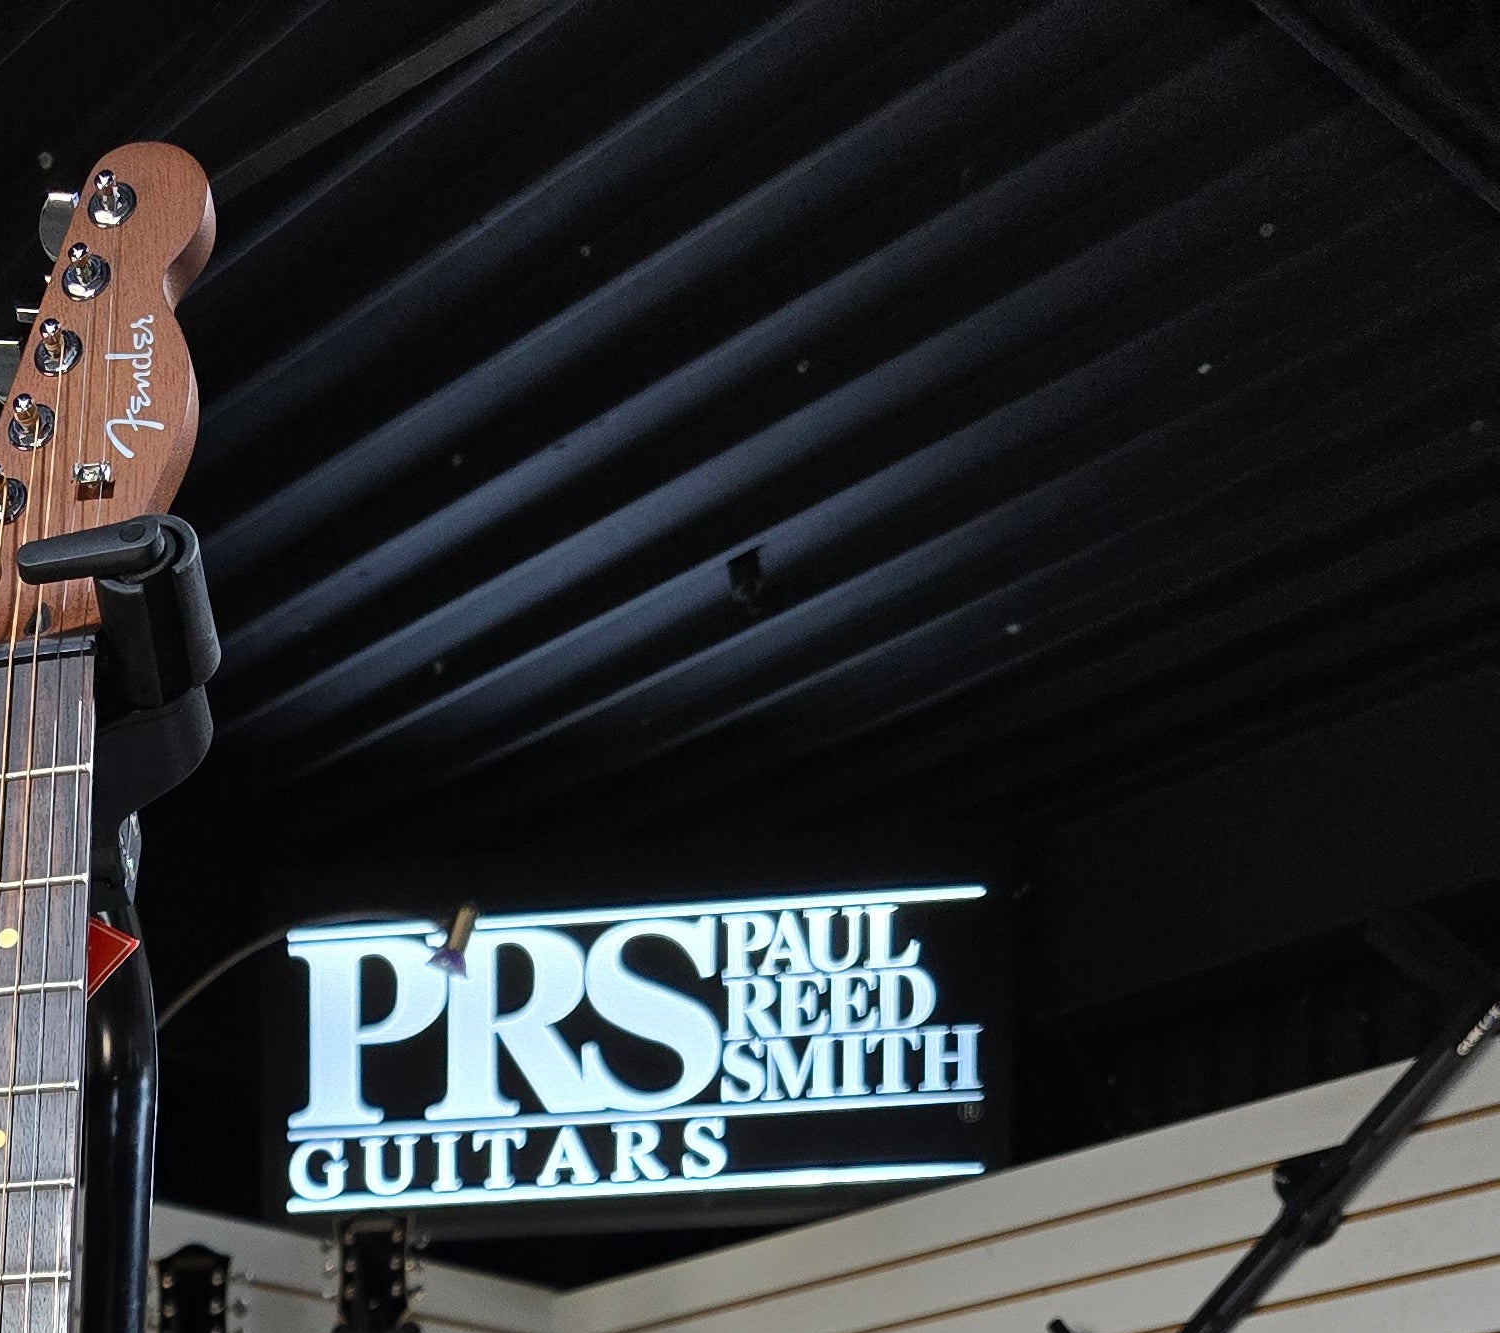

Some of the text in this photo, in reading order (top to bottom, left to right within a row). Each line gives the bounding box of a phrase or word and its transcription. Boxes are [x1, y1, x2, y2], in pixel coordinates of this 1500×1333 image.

[105, 314, 164, 459] Fender
[721, 904, 922, 979] PAUL
[288, 916, 722, 1126] PRS
[723, 966, 938, 1042] REED
[719, 1023, 984, 1104] SMITH
[288, 1116, 729, 1200] GUITARS
